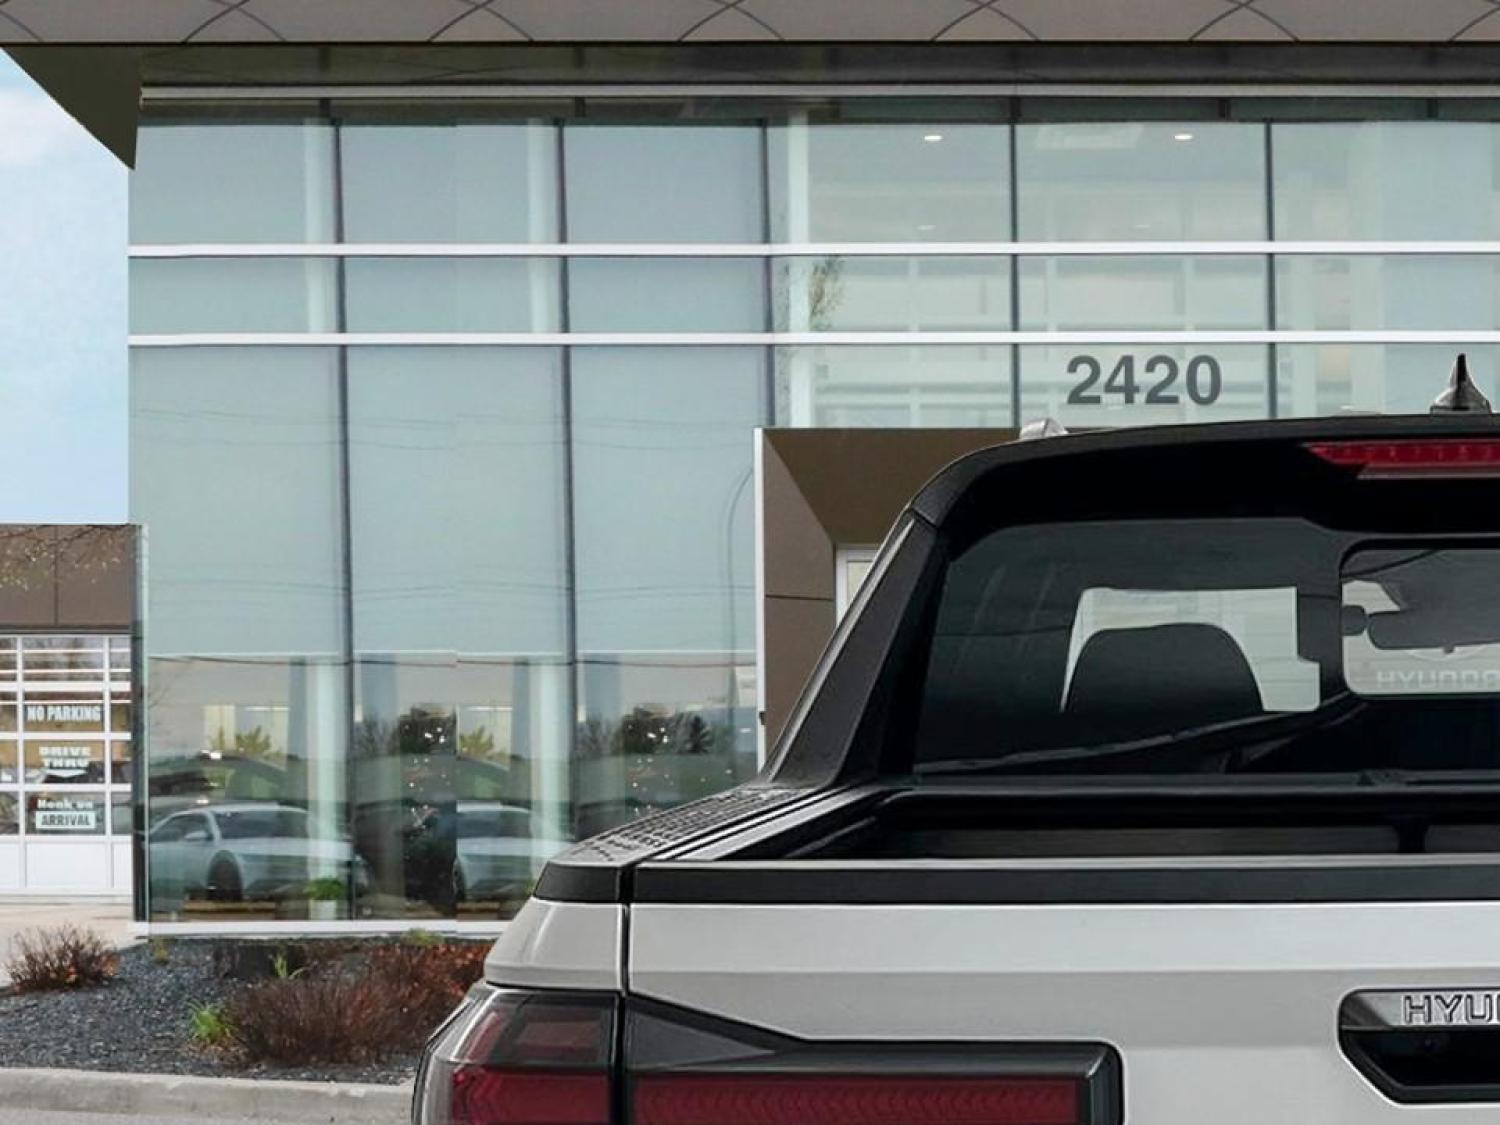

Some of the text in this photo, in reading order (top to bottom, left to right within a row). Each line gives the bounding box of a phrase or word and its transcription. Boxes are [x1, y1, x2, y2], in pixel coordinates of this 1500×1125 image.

[1067, 354, 1222, 406] 2420
[27, 705, 101, 721] NO PARKING
[41, 814, 91, 826] ARRIVAL
